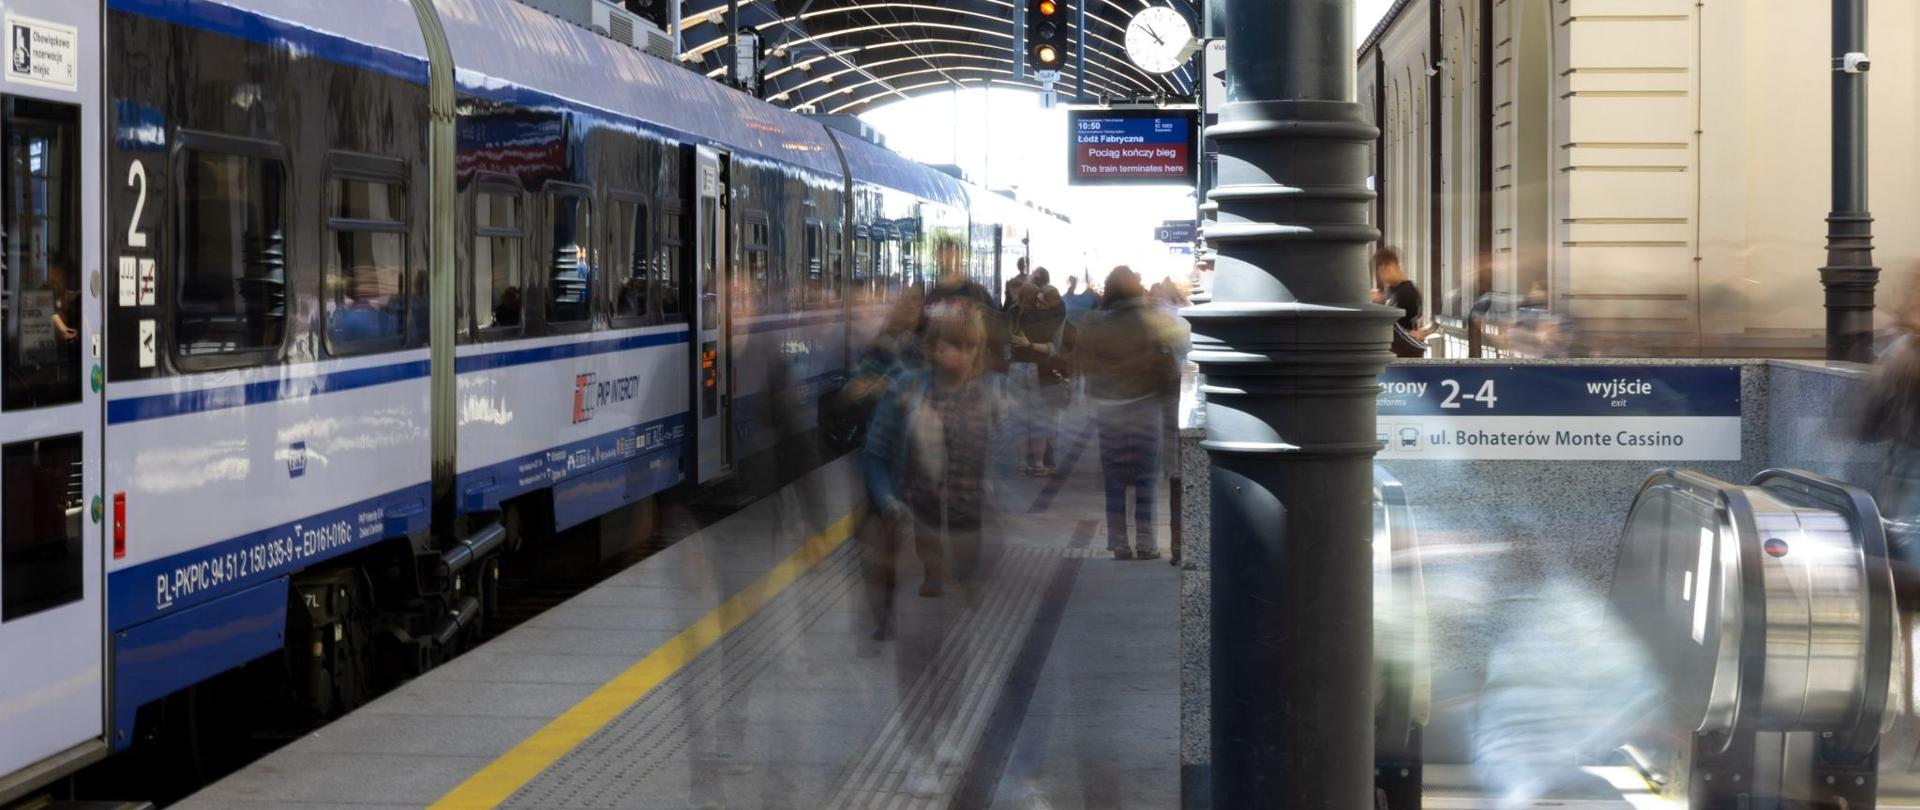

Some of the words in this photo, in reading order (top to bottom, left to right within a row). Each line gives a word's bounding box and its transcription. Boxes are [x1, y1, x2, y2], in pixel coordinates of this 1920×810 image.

[32, 49, 63, 64] rezerwacja
[32, 63, 50, 78] miejsc
[1078, 121, 1101, 130] 10:50
[1078, 134, 1099, 143] Łódź
[1100, 134, 1144, 145] Fabryczna
[1088, 148, 1120, 159] Pociąg
[1122, 147, 1154, 159] kończy
[1156, 147, 1177, 159] bieg
[1081, 164, 1098, 173] The
[1099, 164, 1118, 173] train
[1119, 164, 1163, 173] terminates
[1164, 164, 1184, 173] here
[128, 158, 147, 247] 2
[1160, 230, 1169, 240] D
[611, 375, 640, 403] INTERCITY
[1377, 381, 1428, 397] erony
[1440, 378, 1498, 409] 2-4
[1586, 378, 1652, 398] wyjście
[1611, 399, 1627, 407] exit
[1430, 430, 1451, 445] ul.
[1456, 430, 1550, 446] Bohaterów
[1555, 430, 1612, 446] Monte
[1616, 430, 1684, 446] Cassino
[156, 561, 210, 610] PL-PKPIC
[211, 558, 224, 586] 94
[225, 555, 238, 581] 51
[240, 553, 247, 577] 2
[249, 548, 265, 574] 150
[267, 537, 293, 569] 335-9
[303, 521, 352, 558] ED161-016c
